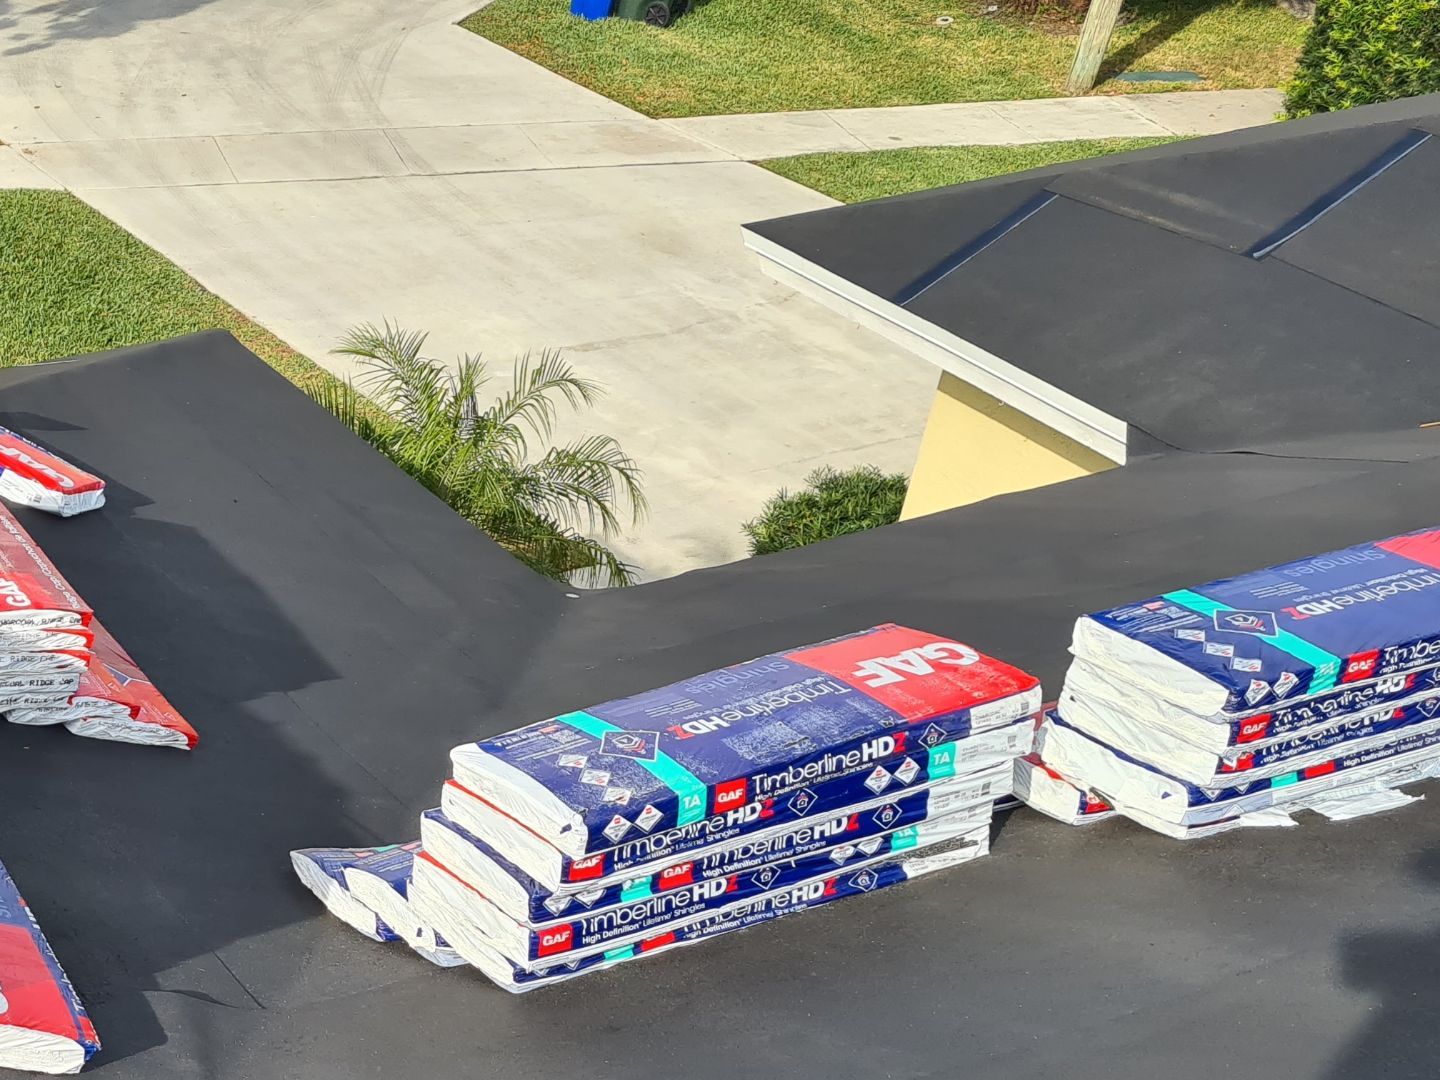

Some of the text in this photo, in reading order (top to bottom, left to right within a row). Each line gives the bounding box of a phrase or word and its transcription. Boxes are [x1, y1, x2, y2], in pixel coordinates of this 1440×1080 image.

[1283, 549, 1386, 578] Shingles
[686, 661, 790, 696] Shingles
[851, 641, 980, 689] GAF
[729, 679, 854, 723] Timberline
[666, 713, 733, 741] HDZ
[1242, 722, 1267, 735] GAF
[716, 732, 906, 803] GAF Timberline HDZ
[933, 751, 950, 764] TA
[683, 794, 703, 809] TA
[572, 856, 603, 870] GAF
[726, 799, 774, 827] HDZ
[663, 864, 691, 878] GAF
[812, 812, 859, 839] HDZ
[702, 867, 722, 878] High
[723, 856, 763, 873] Definition
[791, 876, 837, 904] HDZ
[542, 876, 738, 947] GAF Timberline HDZ
[582, 932, 601, 945] High
[602, 922, 640, 940] Definition
[673, 903, 706, 918] Shingles
